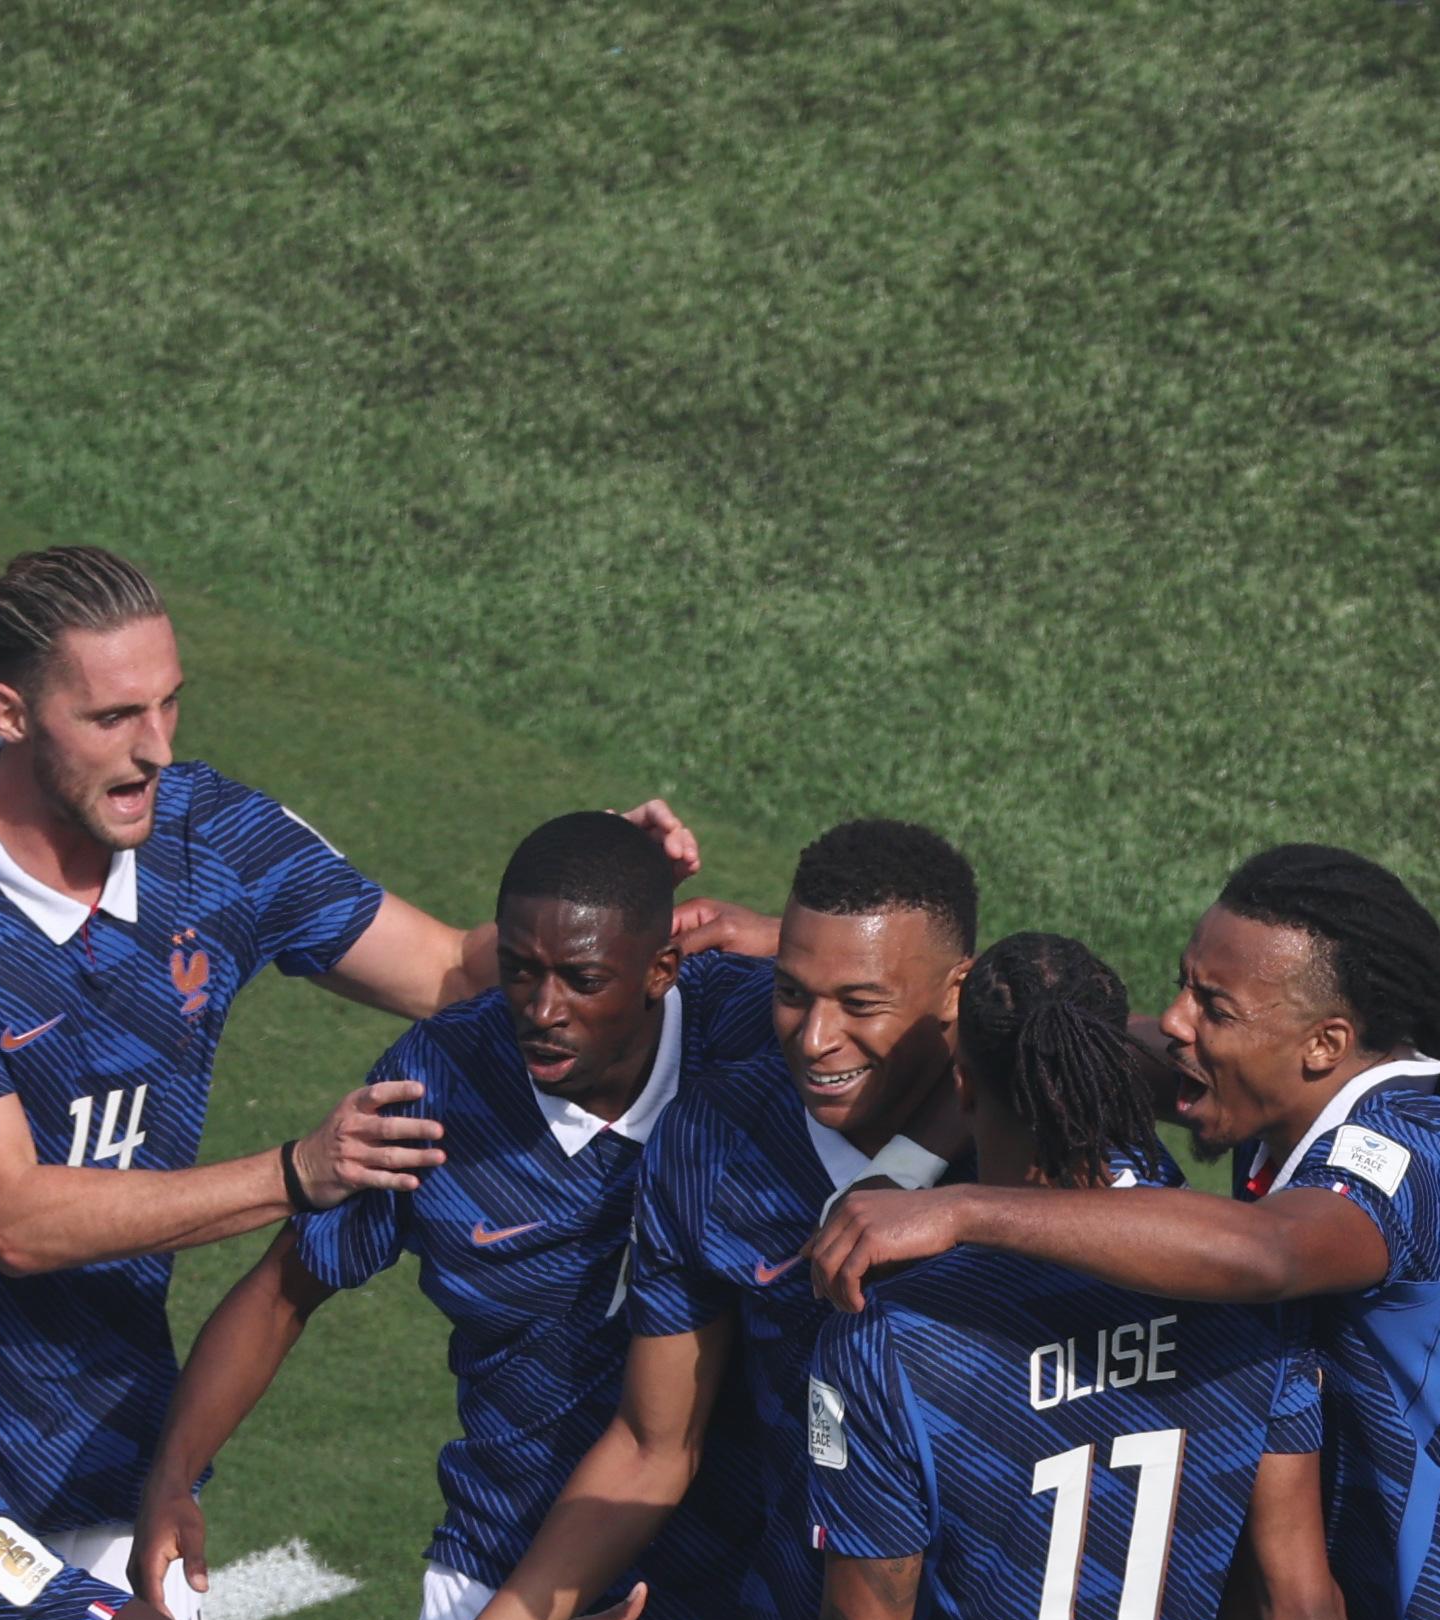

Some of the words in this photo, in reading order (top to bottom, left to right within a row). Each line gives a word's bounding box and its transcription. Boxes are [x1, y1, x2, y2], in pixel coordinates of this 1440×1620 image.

[67, 1084, 148, 1170] 14
[1351, 1152, 1384, 1173] PEACE
[1029, 1315, 1177, 1411] OLISE
[810, 1430, 831, 1448] EACE
